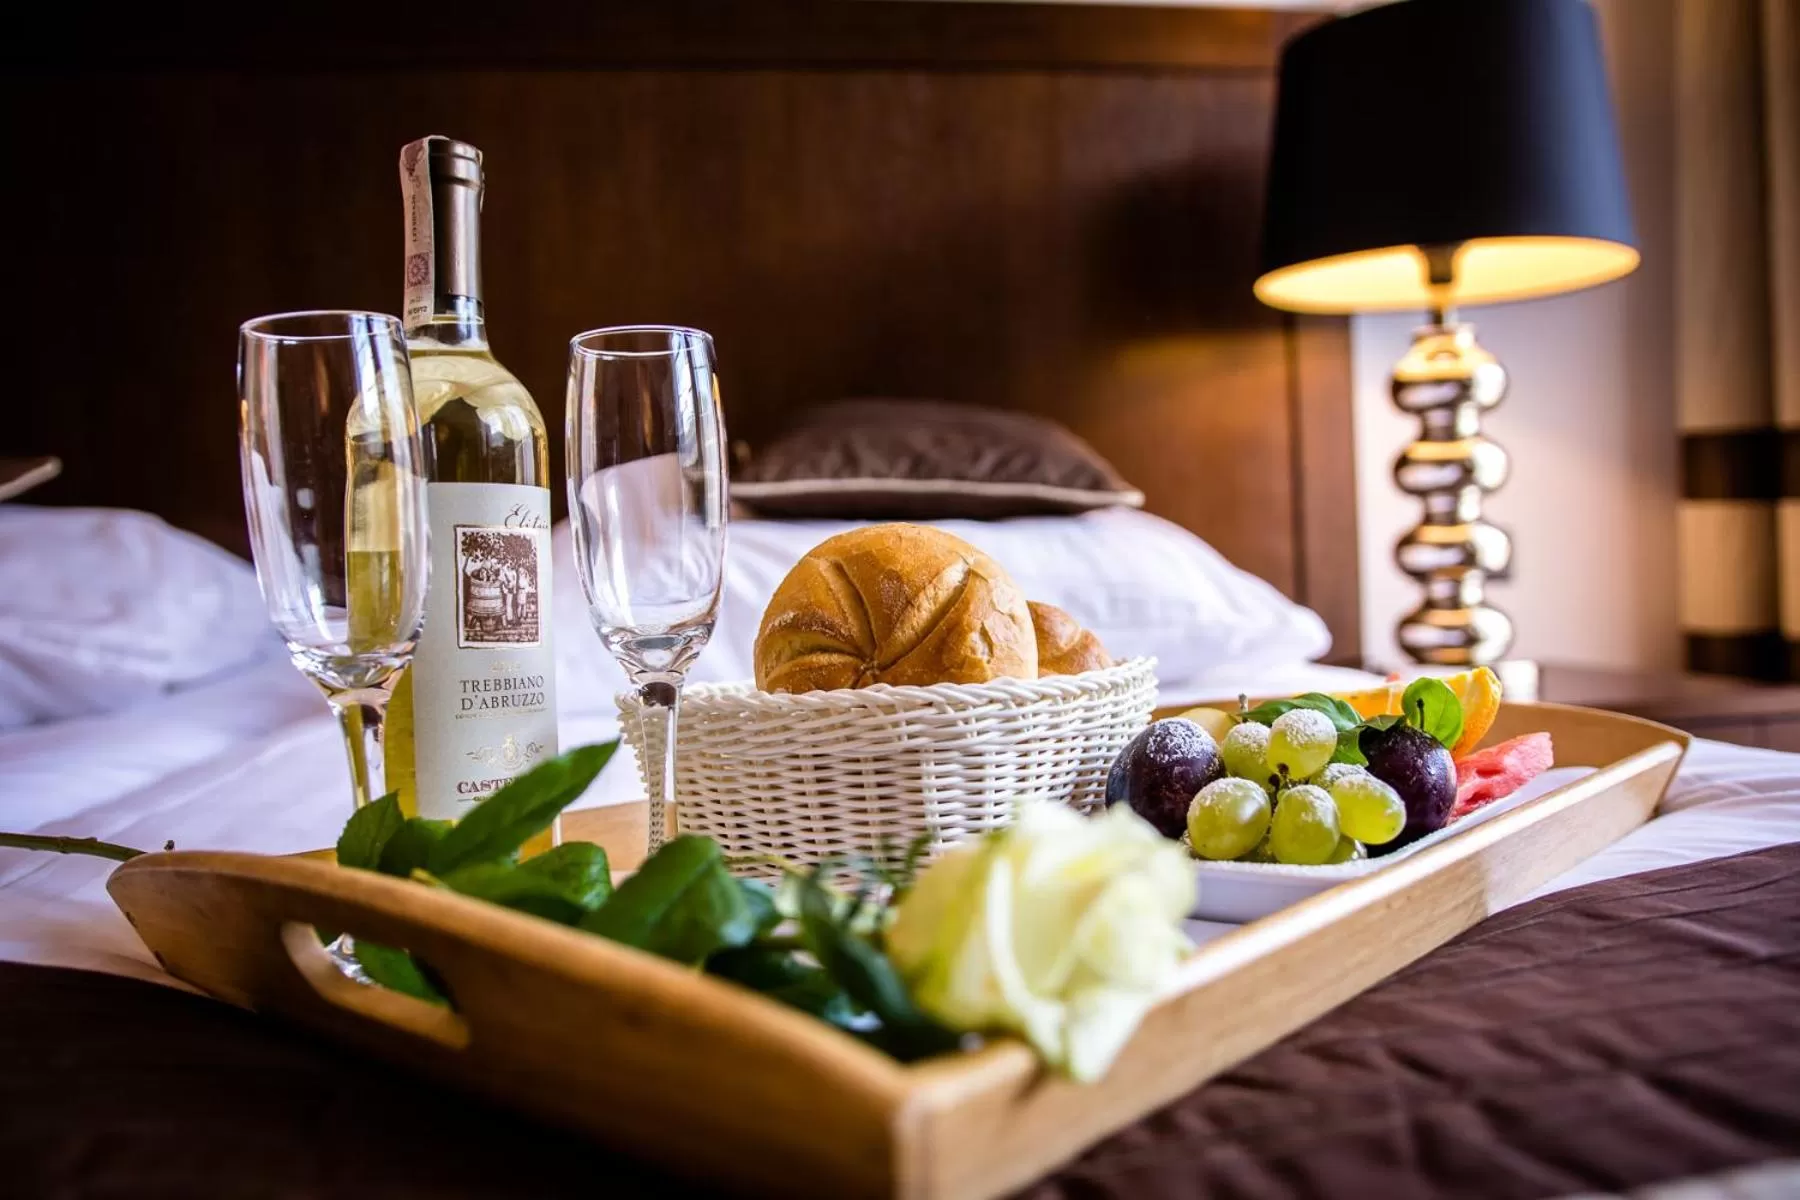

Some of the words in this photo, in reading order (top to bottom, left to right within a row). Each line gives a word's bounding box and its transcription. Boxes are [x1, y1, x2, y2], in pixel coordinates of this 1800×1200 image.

[460, 675, 544, 693] TREBBIANO
[461, 692, 545, 711] D'ABRUZZO
[456, 777, 514, 794] CASTE
